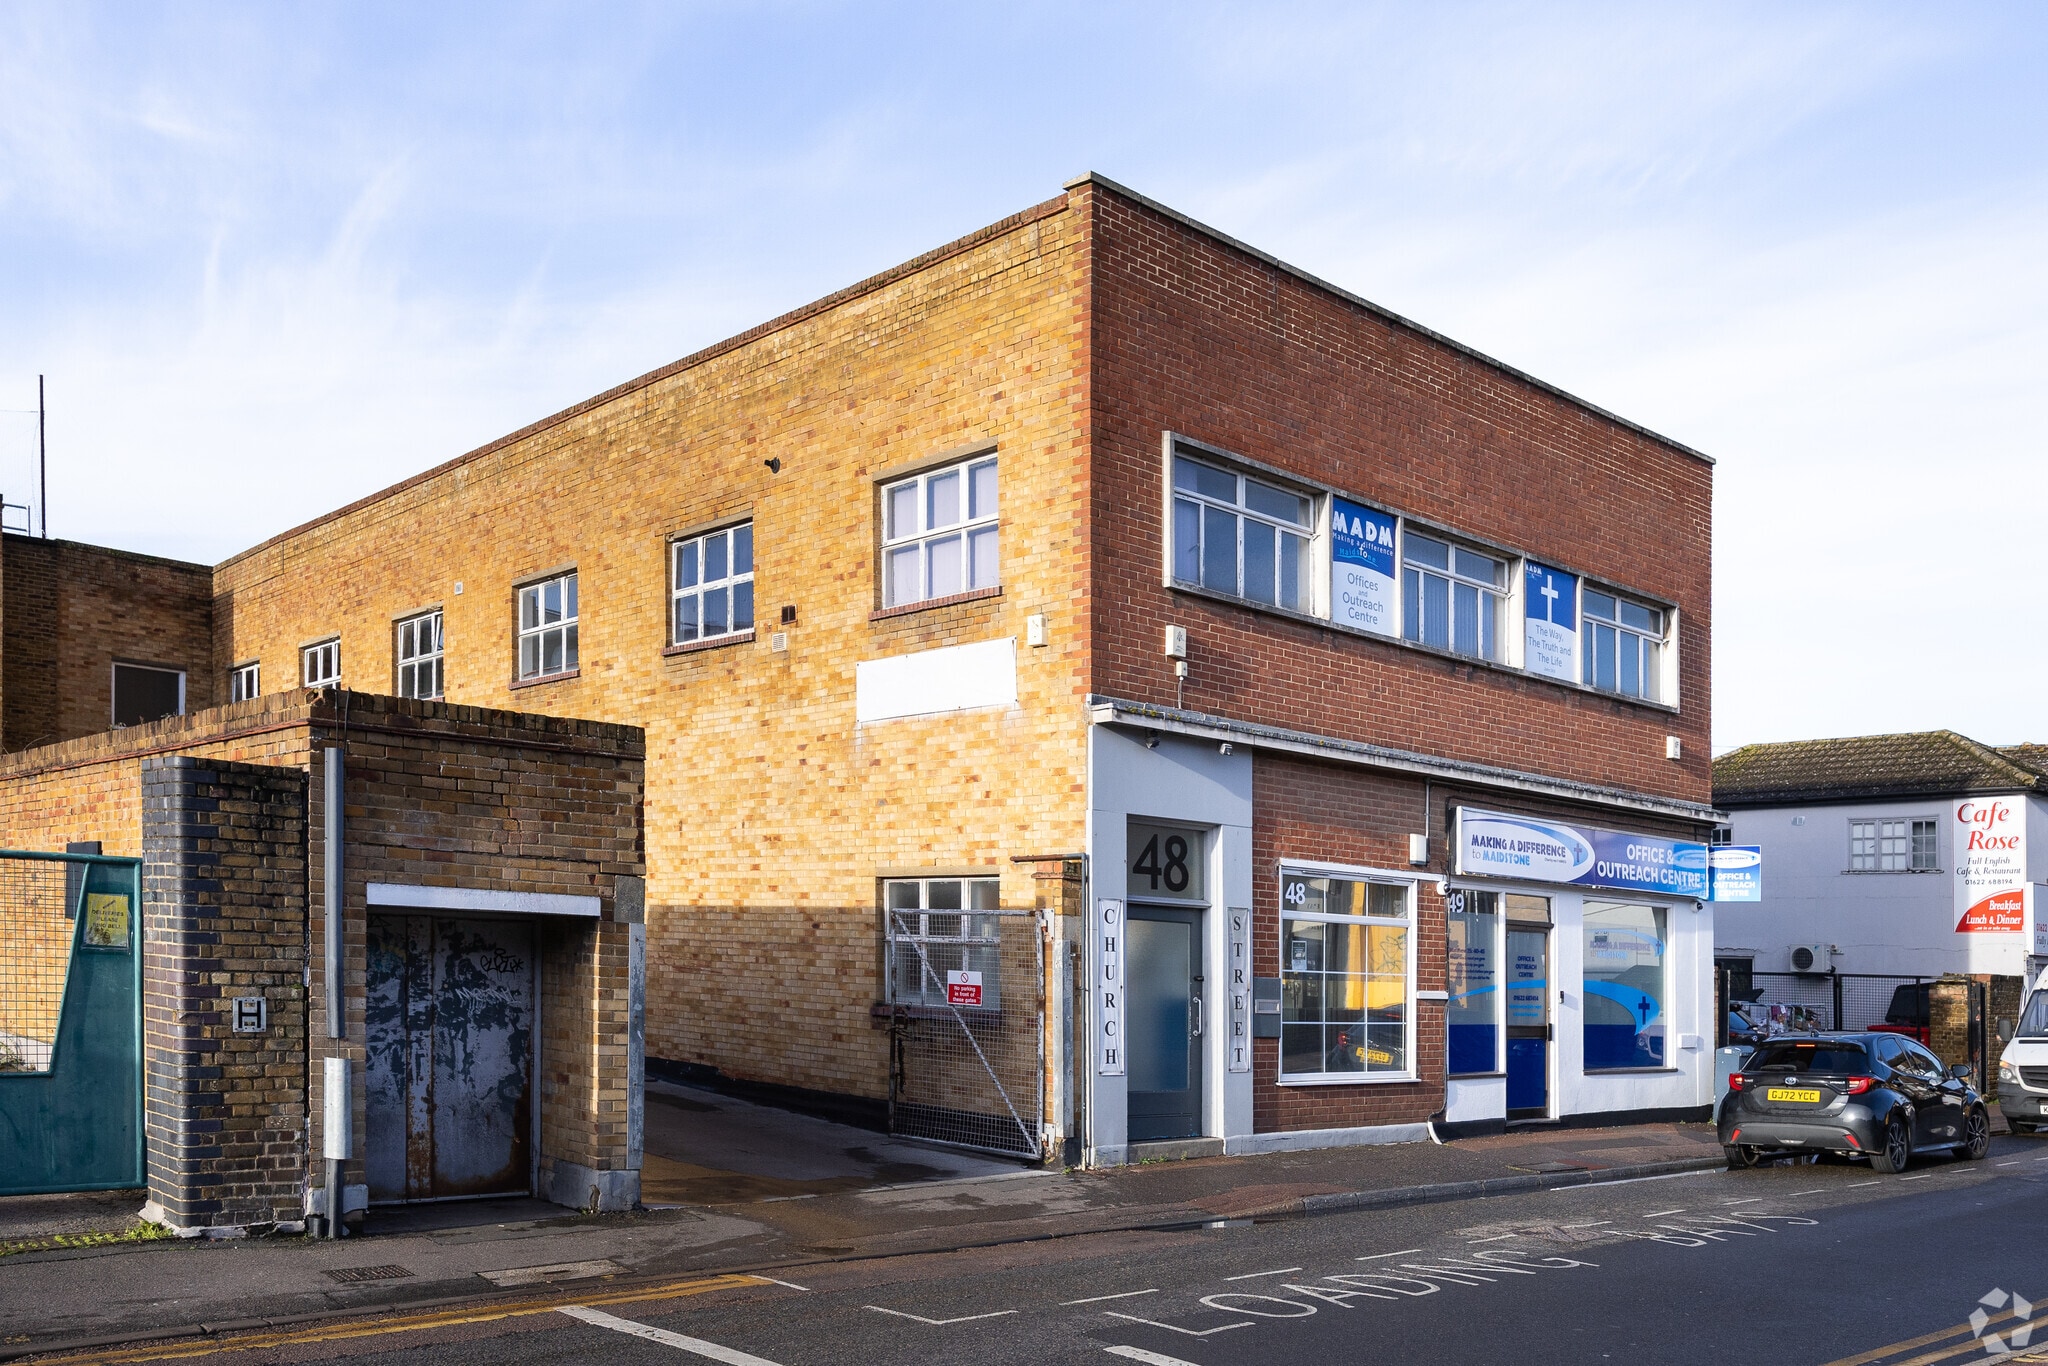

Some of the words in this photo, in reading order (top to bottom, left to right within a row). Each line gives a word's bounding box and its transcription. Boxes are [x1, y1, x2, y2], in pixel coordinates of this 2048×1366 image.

[1333, 511, 1393, 548] MADM
[1333, 532, 1354, 546] Making
[1362, 542, 1394, 556] difference
[1347, 572, 1379, 591] Offices
[1342, 591, 1384, 613] Outreach
[1348, 606, 1378, 625] Centre
[1536, 624, 1548, 636] The
[1528, 635, 1541, 648] The
[1542, 639, 1559, 653] Truth
[1559, 646, 1572, 656] and
[1537, 651, 1550, 664] The
[1551, 655, 1562, 667] Life
[1957, 801, 2010, 831] Cafe
[1471, 834, 1507, 851] MAKING
[1509, 839, 1516, 852] A
[1517, 840, 1566, 858] DIFFERENCE
[1966, 830, 2020, 851] Rose
[1132, 833, 1189, 892] 48
[1472, 848, 1481, 860] to
[1482, 850, 1530, 866] MAIDSTONE
[1626, 843, 1665, 864] OFFICE
[1666, 849, 1674, 865] &
[1597, 861, 1658, 883] OUTREACH
[1660, 868, 1700, 888] CENTRE
[1717, 872, 1741, 881] OFFICE
[1956, 867, 1972, 878] Cafe
[1285, 882, 1306, 905] 48
[1713, 881, 1756, 889] OUTREACH
[1449, 893, 1465, 913] 49
[1989, 900, 2022, 914] Breakfast
[1966, 914, 1987, 925] Lunch
[1989, 916, 1995, 925] &
[1996, 914, 2022, 925] Dinner
[1104, 908, 1116, 1065] CHURCH
[1233, 915, 1244, 1063] STREET
[238, 1000, 261, 1028] H
[1771, 1090, 1795, 1100] GJ72
[1798, 1091, 1815, 1101] YCC
[1103, 1250, 1600, 1336] LOADING
